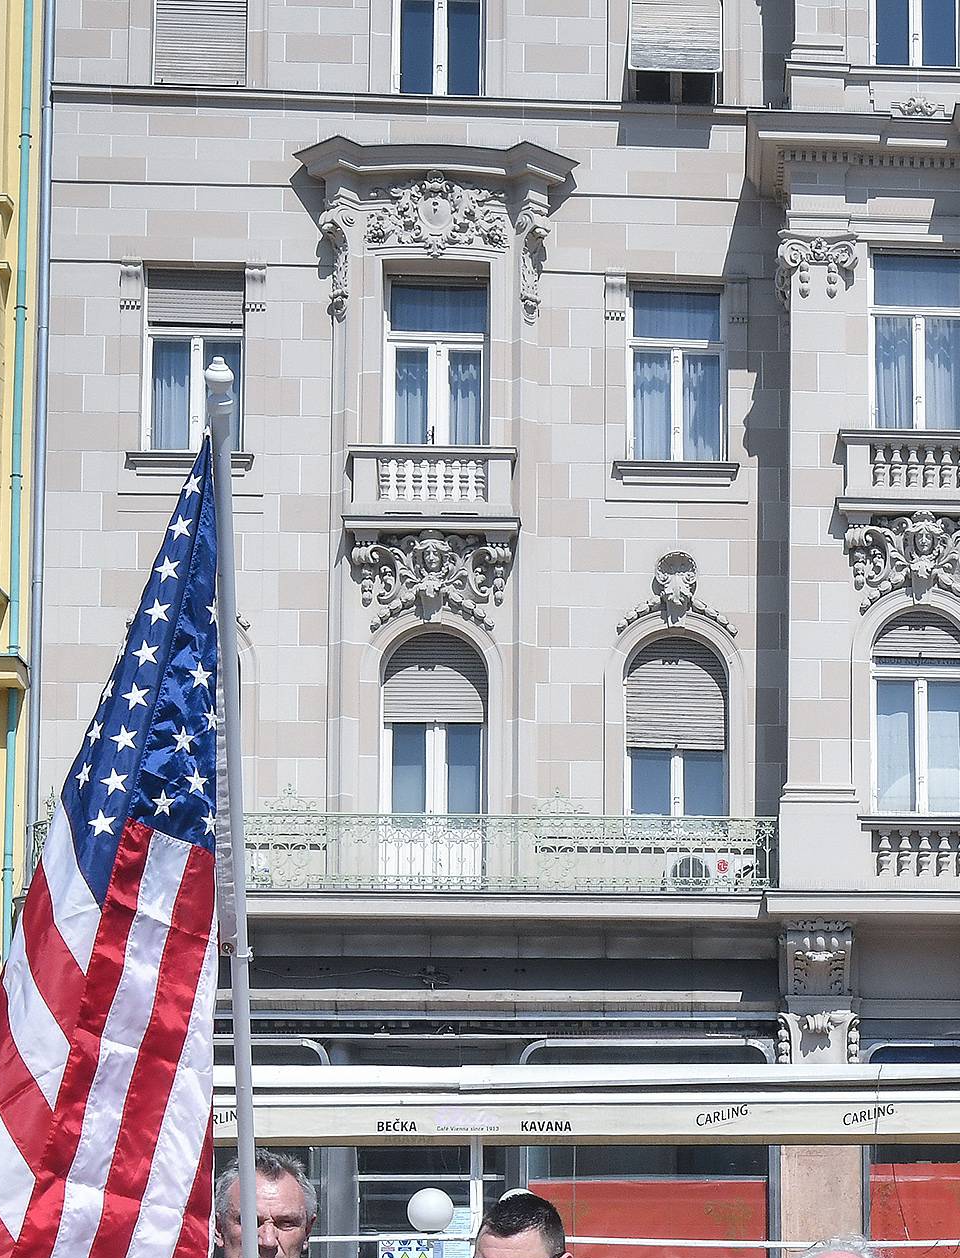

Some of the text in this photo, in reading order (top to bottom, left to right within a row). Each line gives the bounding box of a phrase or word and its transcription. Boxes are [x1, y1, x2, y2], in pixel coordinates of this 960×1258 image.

[213, 1110, 238, 1125] RLIN
[696, 1104, 749, 1127] CARLING
[842, 1104, 895, 1126] CARLING
[376, 1118, 417, 1132] BEČKA
[520, 1120, 572, 1132] KAVANA
